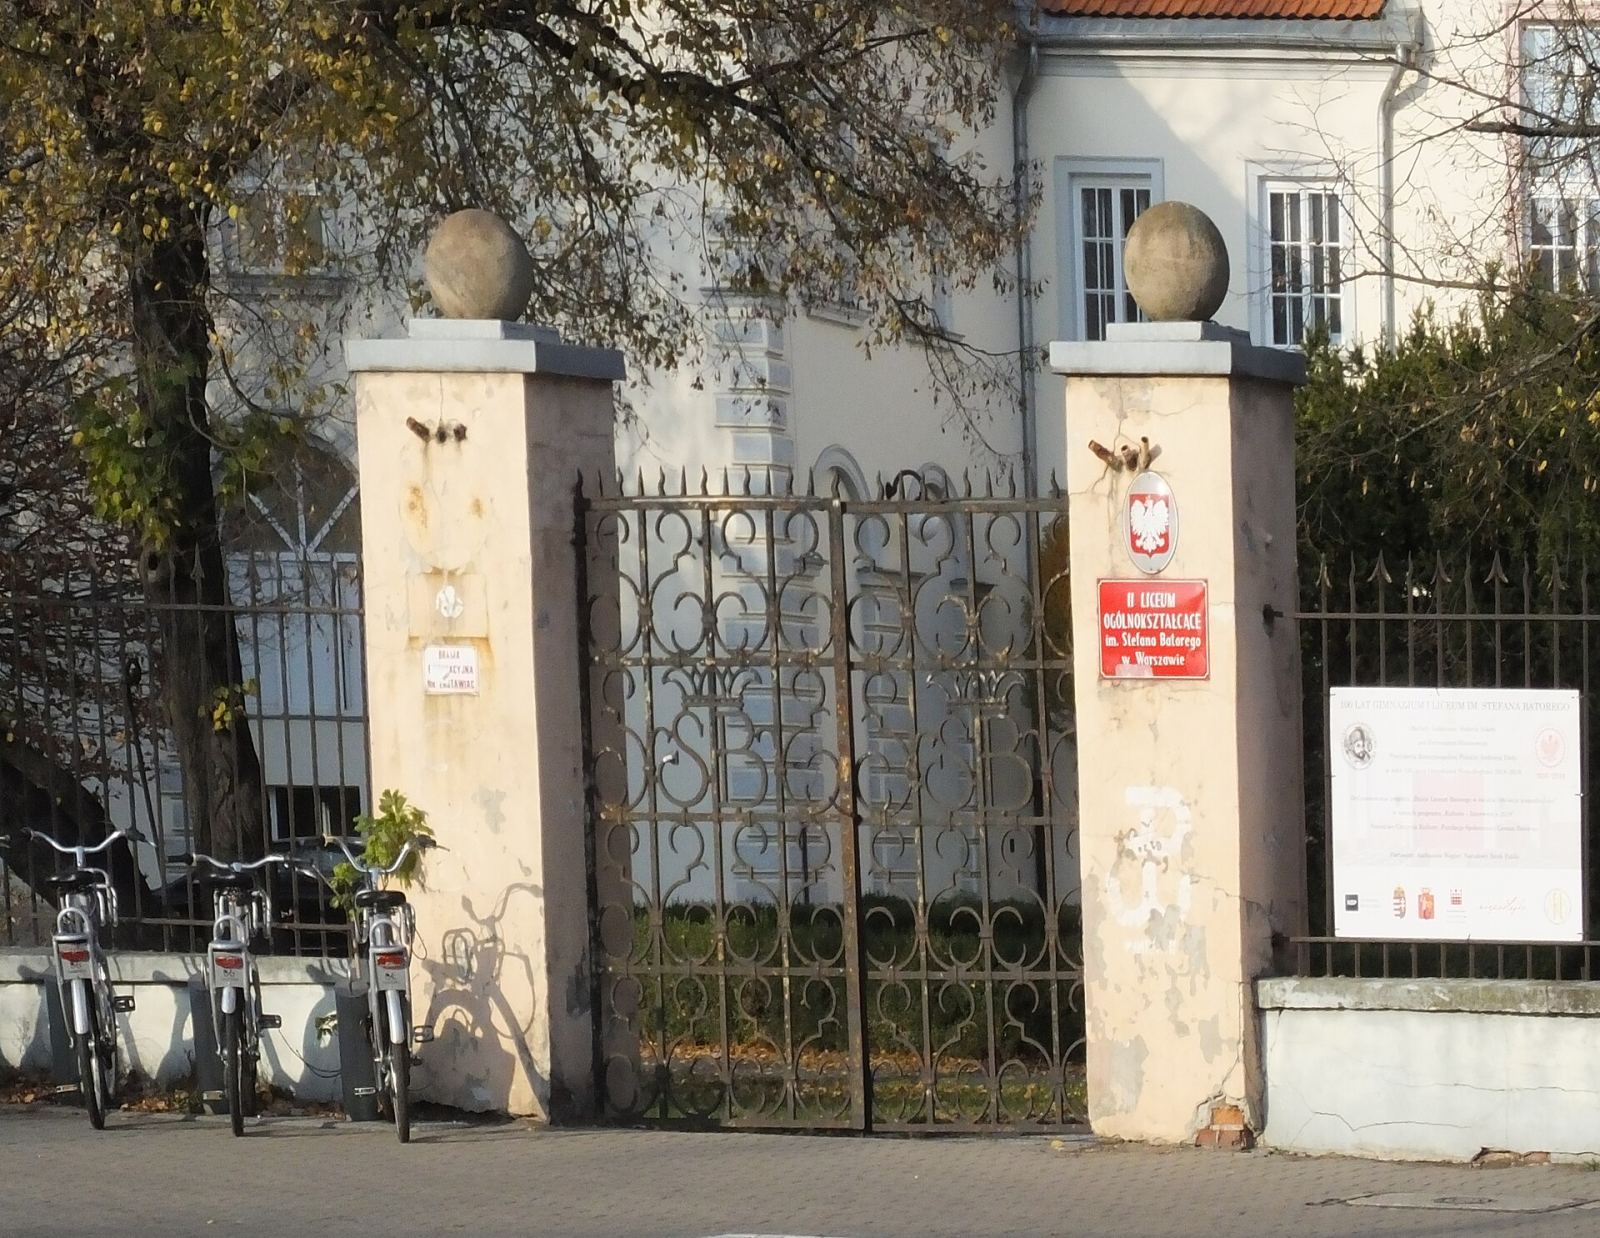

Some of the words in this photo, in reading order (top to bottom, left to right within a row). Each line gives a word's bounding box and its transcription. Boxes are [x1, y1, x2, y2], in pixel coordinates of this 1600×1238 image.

[1127, 592, 1134, 608] II
[1140, 592, 1175, 608] LICEUM
[1104, 611, 1201, 630] OGÓLNOKSZTAŁCĄCE
[1105, 633, 1120, 647] im.
[1122, 632, 1157, 647] Stefana
[1159, 632, 1202, 651] Batorego
[1122, 656, 1131, 665] w
[1134, 651, 1185, 666] Warszawie
[1482, 702, 1521, 712] STEFANA
[1522, 702, 1571, 712] BATOREGO
